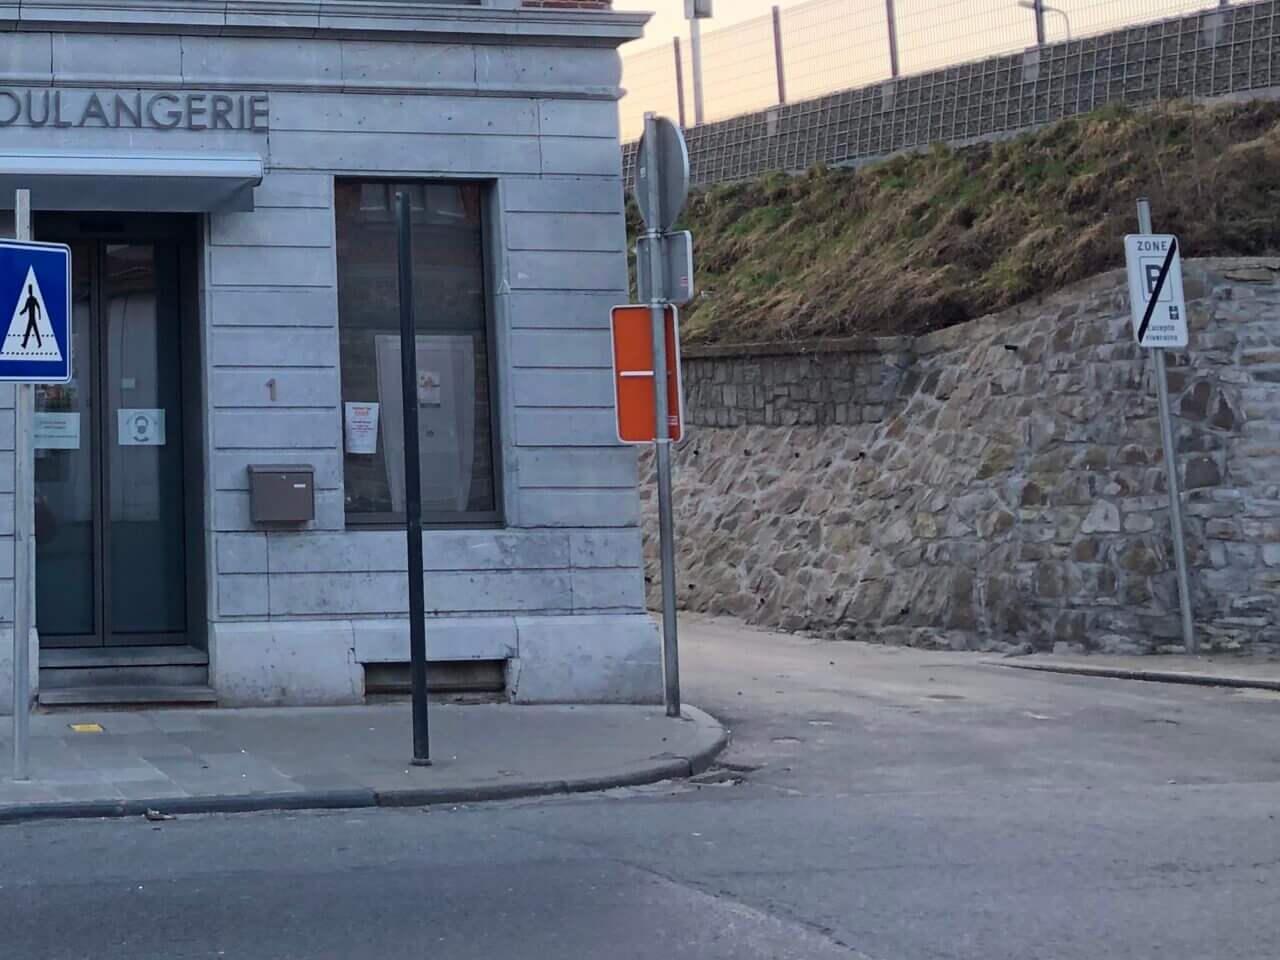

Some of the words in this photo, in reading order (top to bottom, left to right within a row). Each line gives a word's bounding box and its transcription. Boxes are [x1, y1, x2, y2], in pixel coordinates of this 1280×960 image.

[1136, 240, 1168, 252] ZONE
[1145, 264, 1163, 294] P
[264, 378, 277, 402] 1
